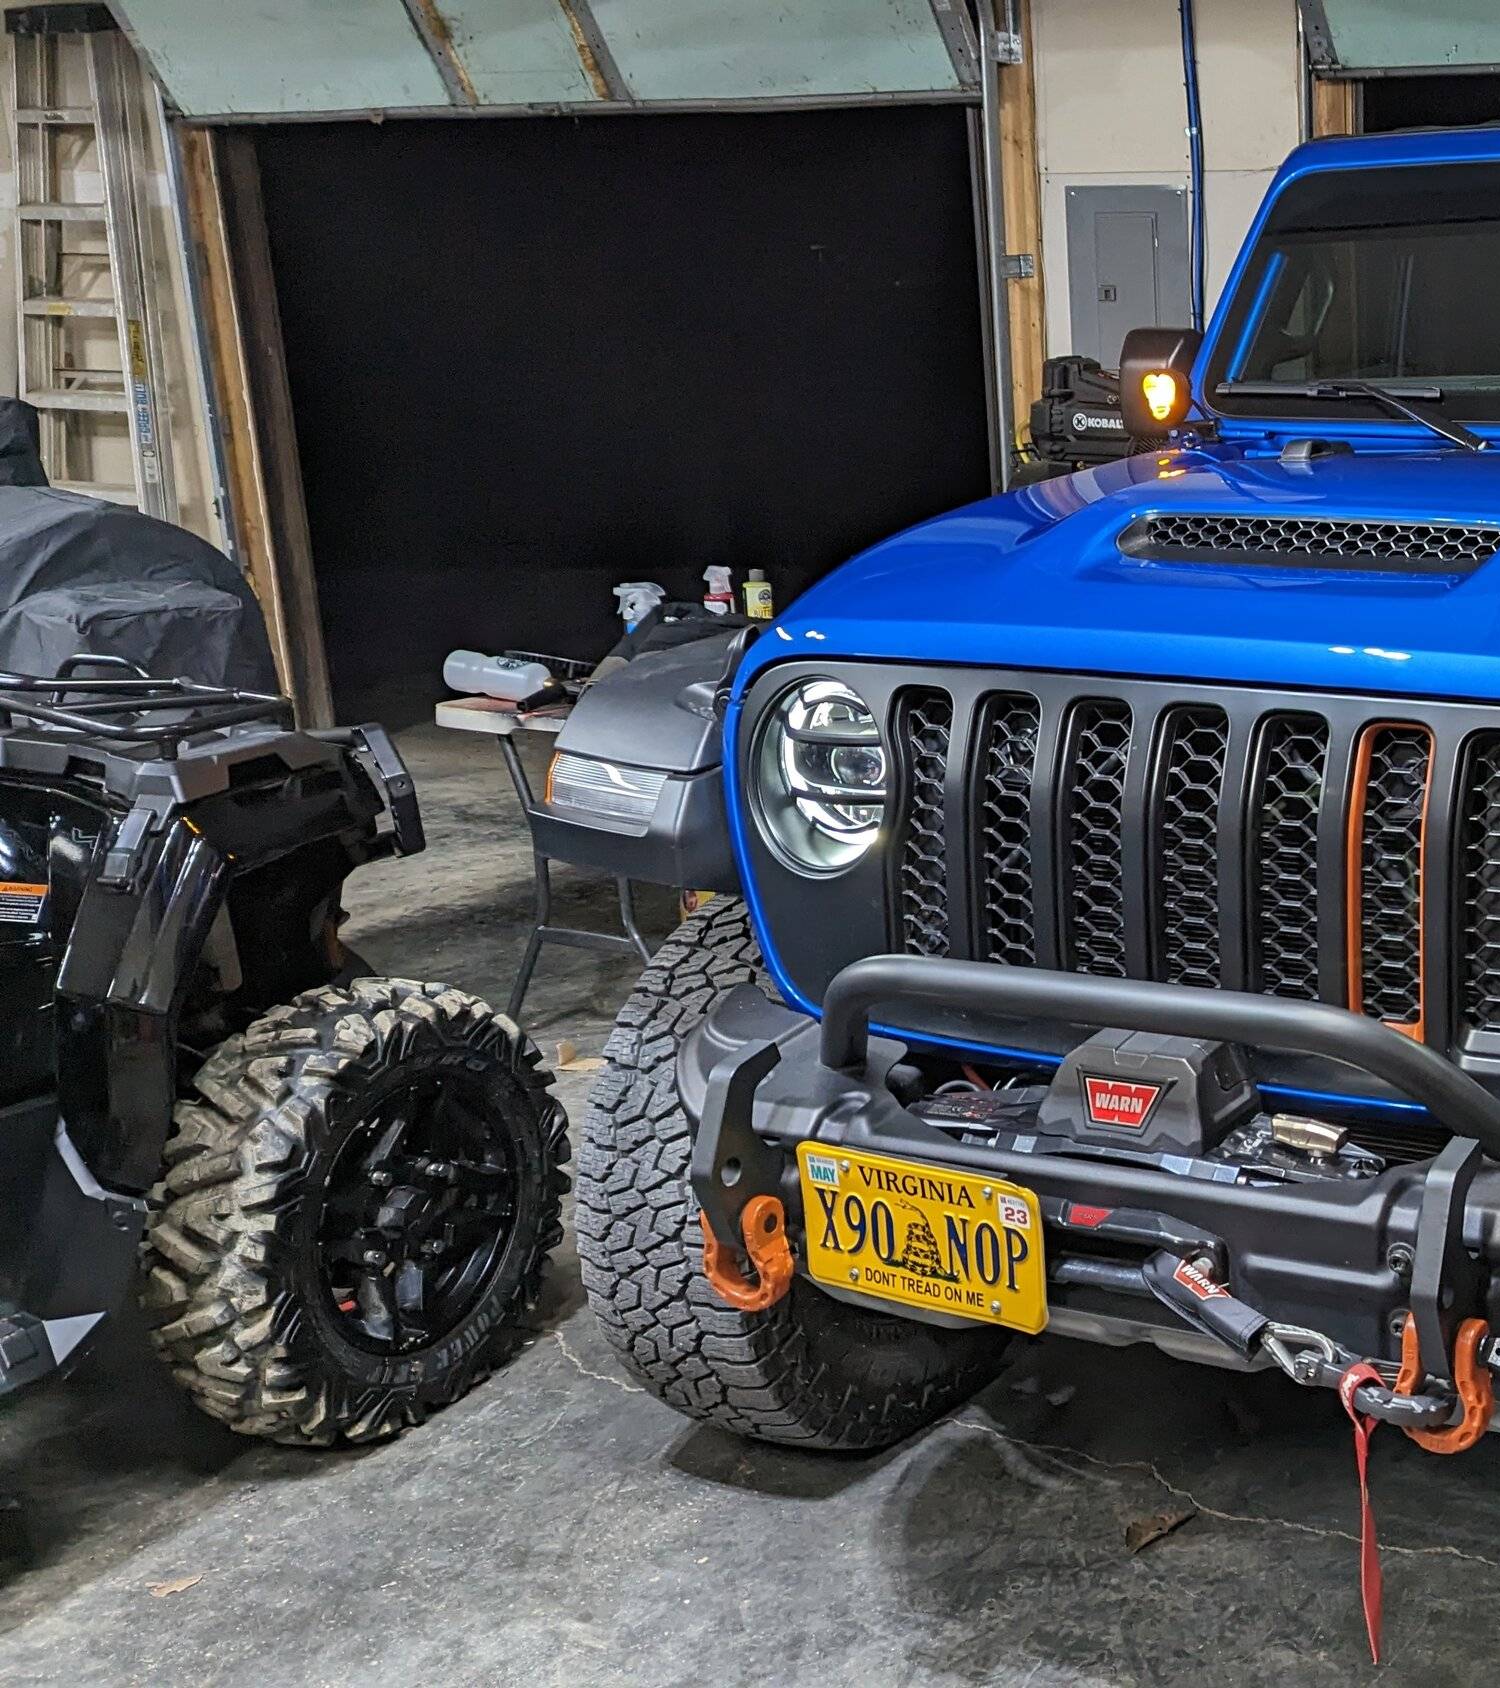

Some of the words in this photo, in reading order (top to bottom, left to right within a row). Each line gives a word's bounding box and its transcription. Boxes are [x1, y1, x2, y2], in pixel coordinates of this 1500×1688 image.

[1087, 419, 1124, 429] KOBAL
[1095, 1092, 1143, 1114] WARN
[810, 1164, 836, 1183] MAY
[858, 1165, 976, 1209] VIRGINIA
[1004, 1206, 1028, 1225] 23
[815, 1187, 896, 1263] X90
[944, 1213, 1028, 1291] NOP
[865, 1267, 896, 1287] DONT
[900, 1276, 941, 1298] TREAD
[944, 1286, 963, 1303] ON
[966, 1291, 984, 1307] ME
[1181, 1264, 1220, 1295] WARN
